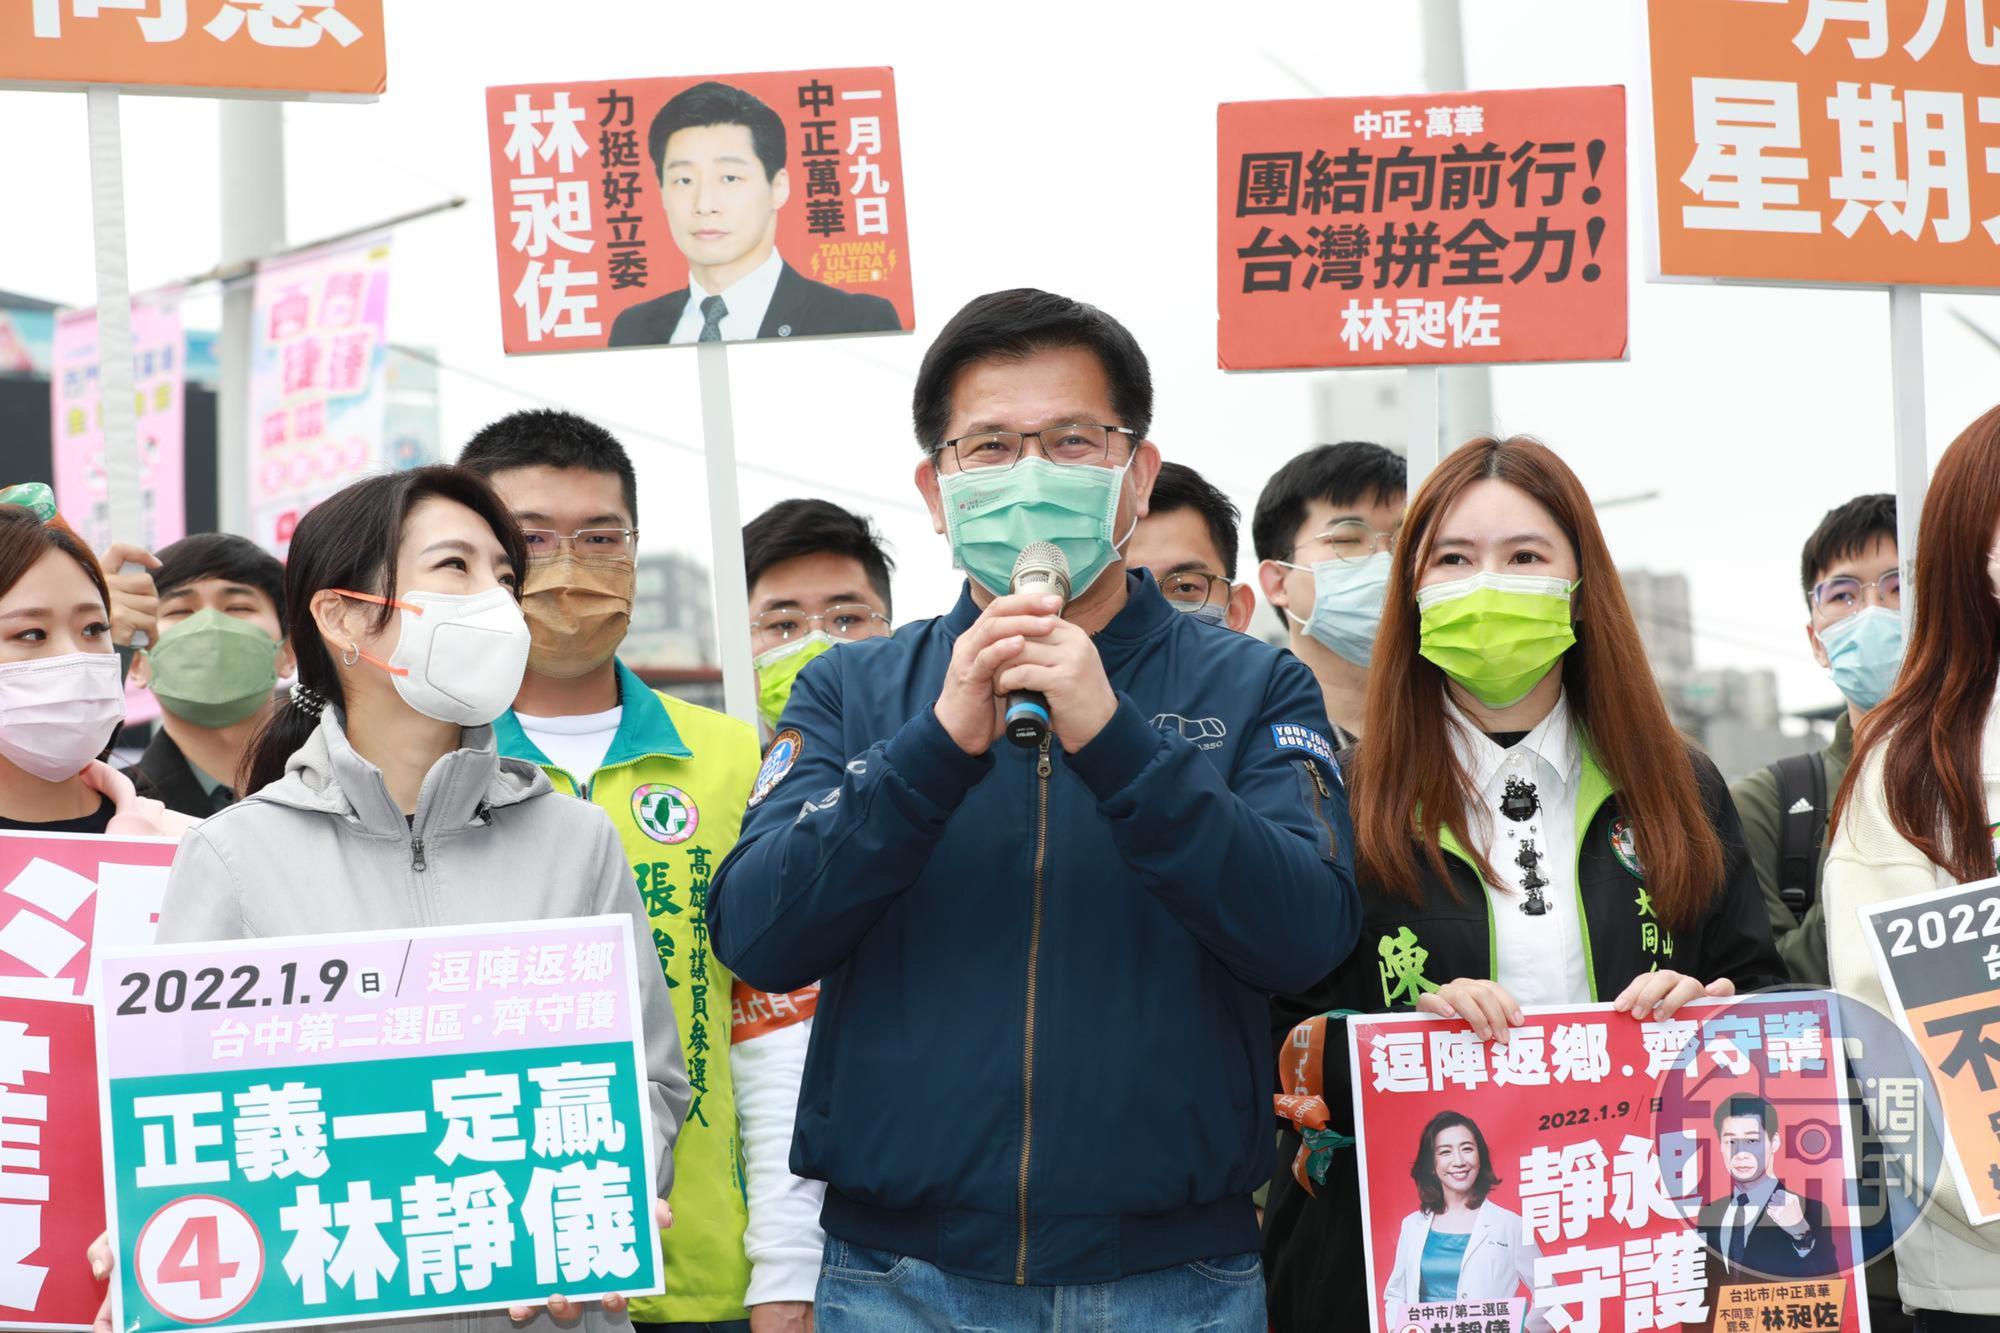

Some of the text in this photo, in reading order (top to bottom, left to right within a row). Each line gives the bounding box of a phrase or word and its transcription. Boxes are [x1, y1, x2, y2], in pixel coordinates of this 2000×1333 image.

[597, 88, 648, 289] 力挺好立委
[798, 79, 846, 238] 中正萬華
[841, 89, 889, 236] 一月九日
[1679, 76, 2000, 245] 星期
[503, 92, 602, 342] 林昶佐
[819, 241, 886, 257] TAIWAN
[826, 256, 884, 270] ULTRA
[1340, 296, 1501, 352] 林昶佐
[116, 958, 349, 1017] 2022.1.9
[426, 941, 616, 994] 逗陣返鄉
[1378, 926, 1441, 1007] 陳
[133, 1061, 626, 1188] 正義一定贏
[157, 1159, 640, 1306] 4 林靜儀
[1533, 1231, 1710, 1333] 守護
[1720, 1308, 1755, 1320] 不同意
[1761, 1302, 1839, 1331] 林昶佐
